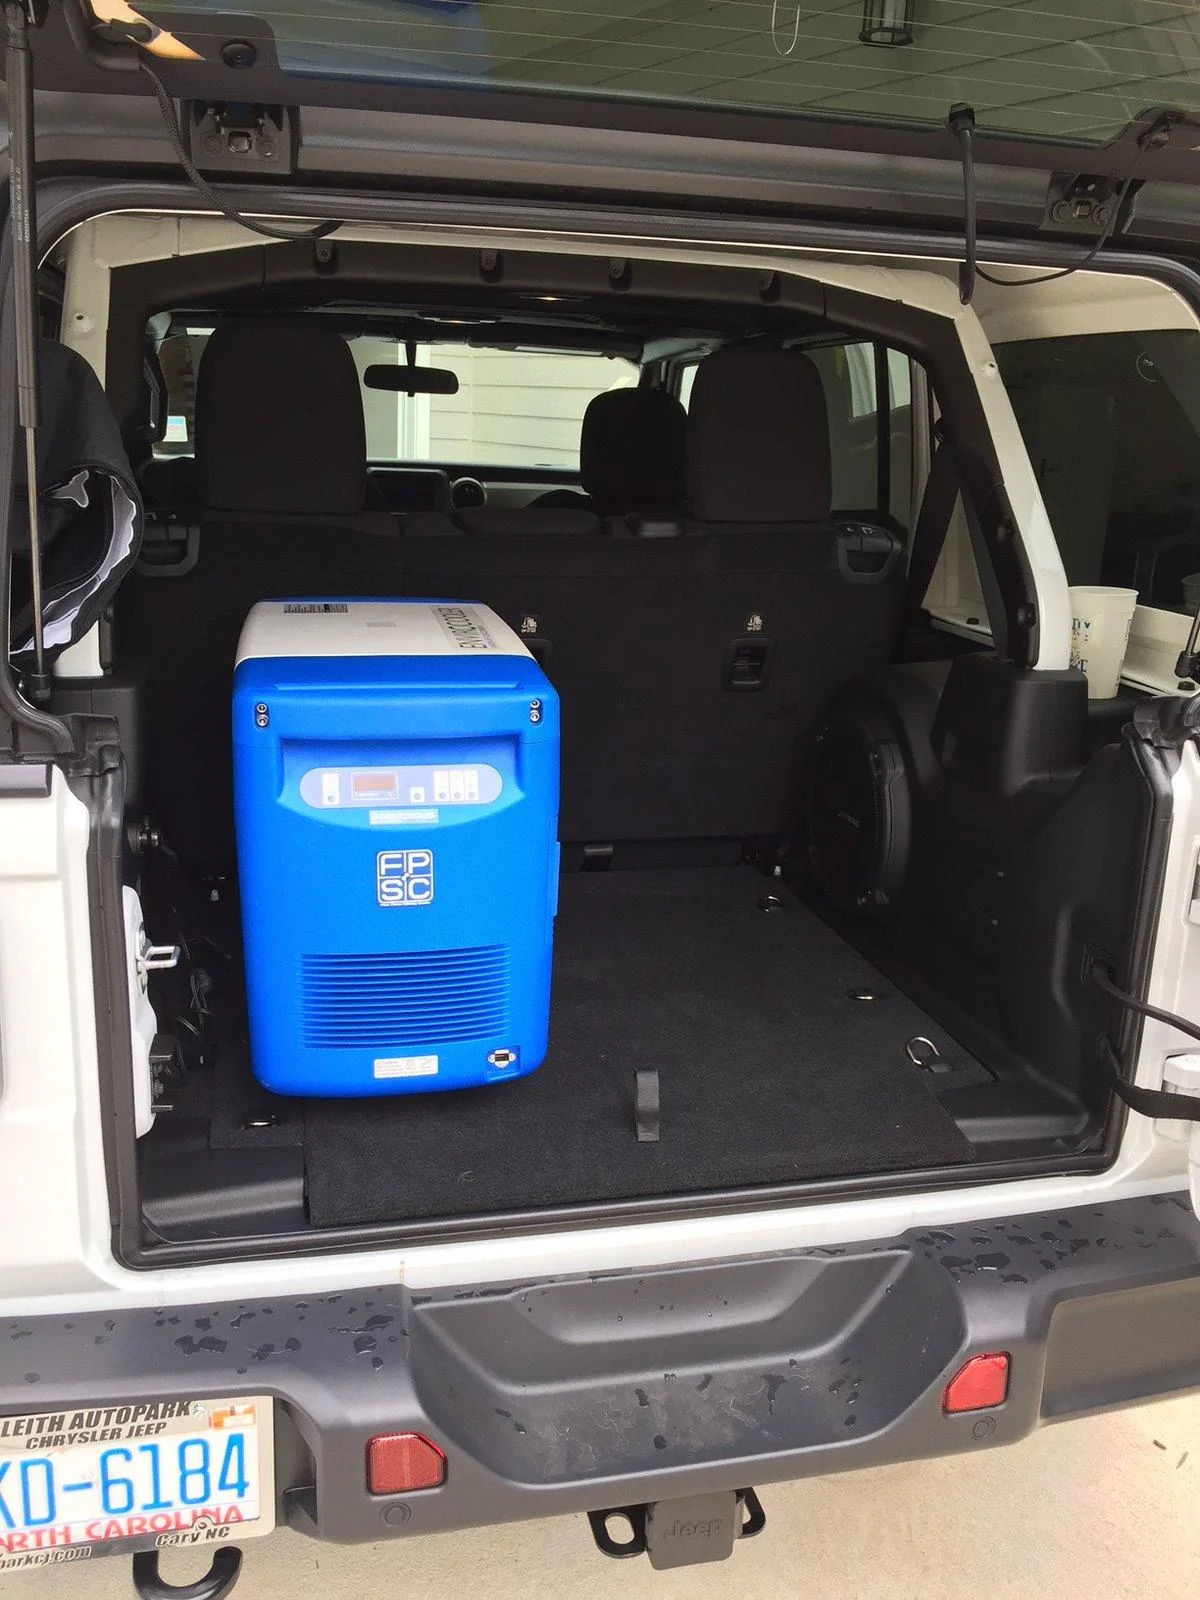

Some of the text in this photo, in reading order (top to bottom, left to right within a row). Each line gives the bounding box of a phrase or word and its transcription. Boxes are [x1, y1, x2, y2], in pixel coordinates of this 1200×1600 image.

[1, 1400, 192, 1437] LEITH AUTOPARK
[26, 1421, 167, 1449] CHRYSLER JEEP
[85, 1505, 244, 1541] CAROLINA
[156, 1530, 201, 1547] Cary
[205, 1526, 230, 1540] NC
[663, 1518, 724, 1540] Jeep
